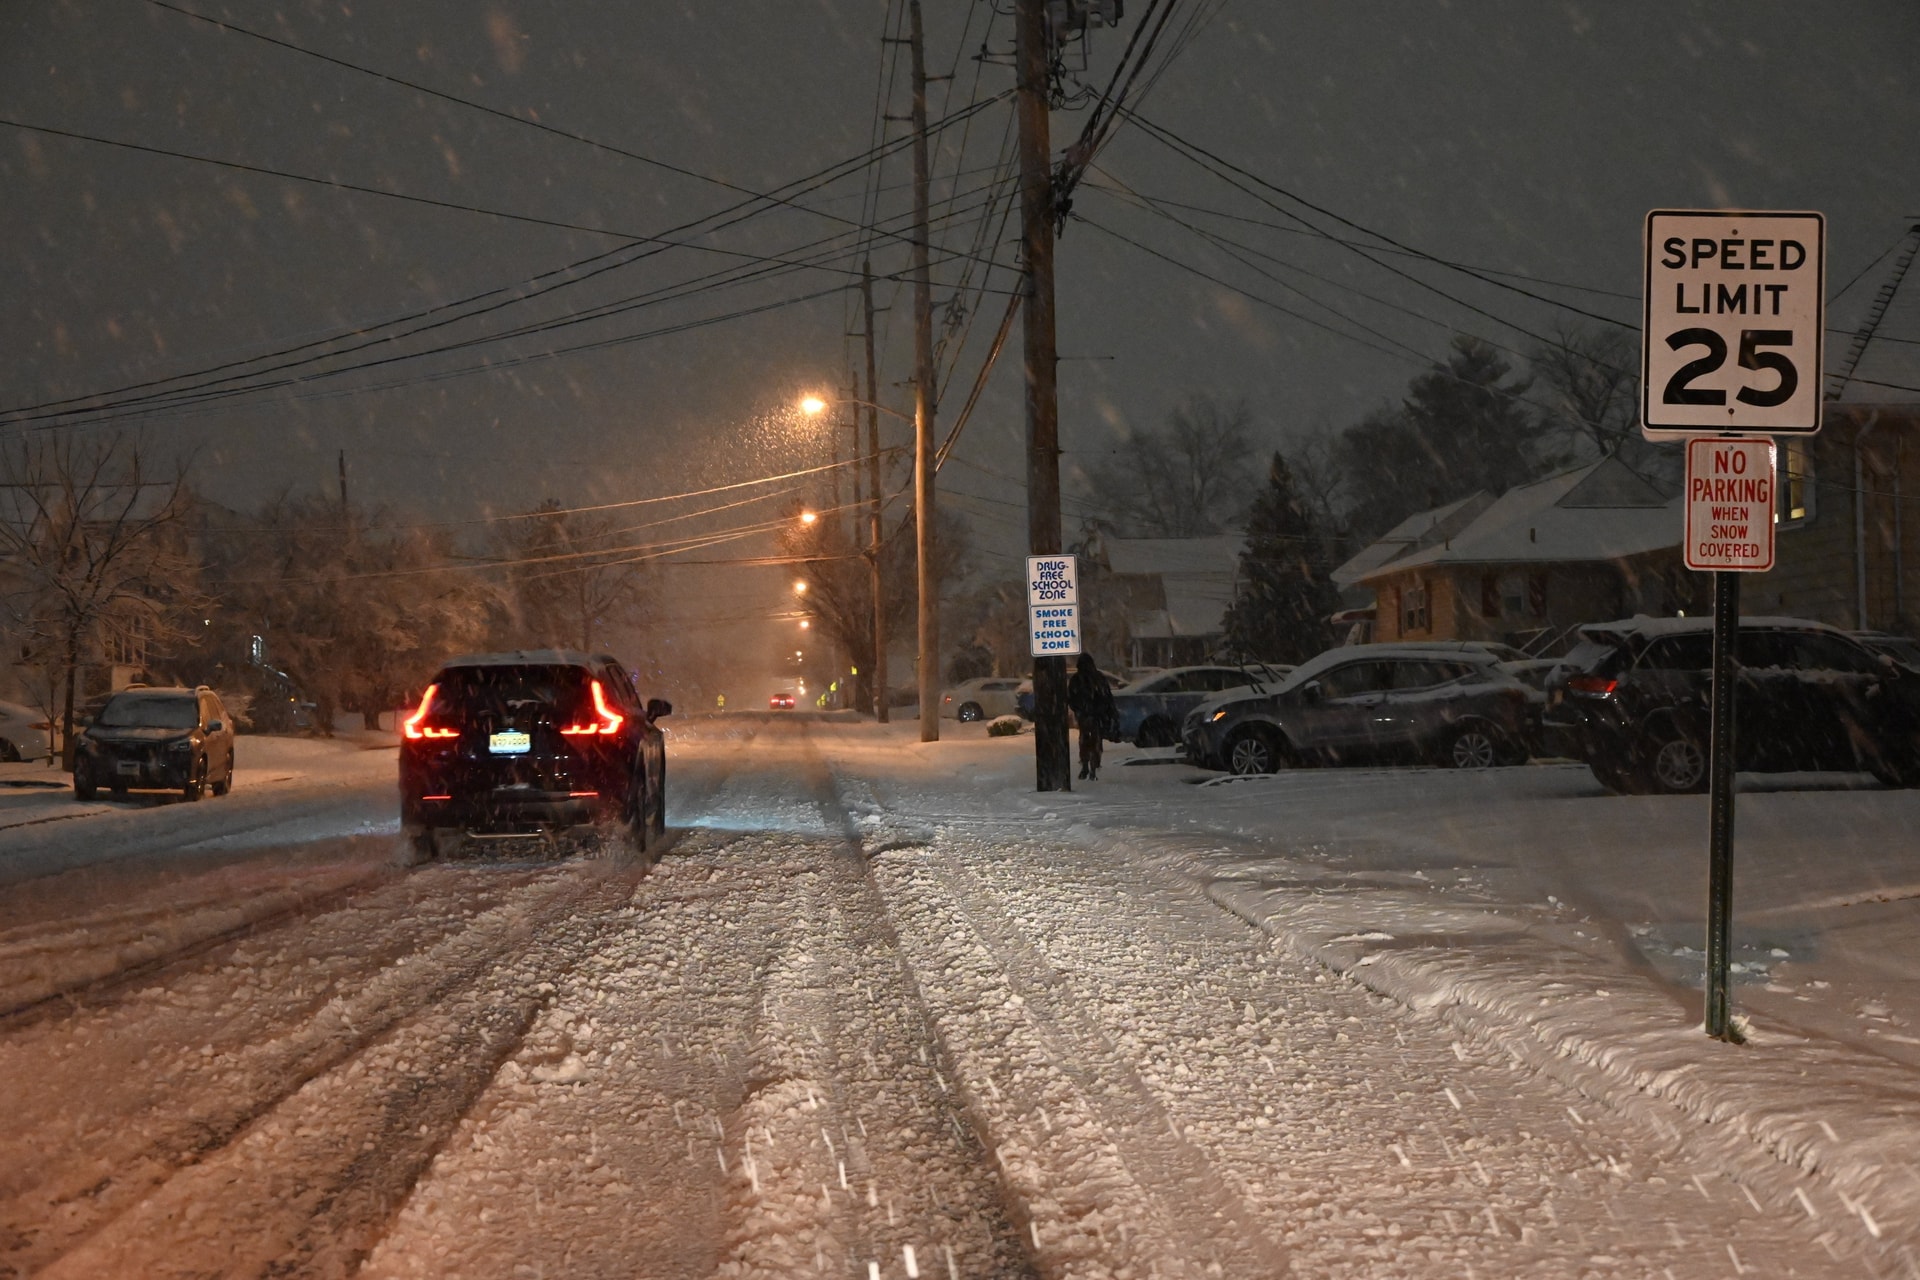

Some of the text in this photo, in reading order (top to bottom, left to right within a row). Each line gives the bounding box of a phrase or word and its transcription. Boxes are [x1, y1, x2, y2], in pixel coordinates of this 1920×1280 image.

[1661, 237, 1806, 270] SPEED
[1676, 283, 1788, 315] LIMIT
[1663, 328, 1798, 407] 25
[1715, 450, 1746, 474] NO
[1693, 478, 1768, 503] PARKING
[1711, 506, 1749, 521] WHEN
[1711, 525, 1748, 539] SNOW
[1699, 543, 1760, 558] COVERED
[1037, 561, 1069, 571] DRUG-
[1040, 571, 1063, 580] FREE
[1032, 580, 1073, 590] SCHOOL
[1039, 590, 1066, 600] ZONE
[1036, 609, 1073, 618] SMOKE
[1043, 620, 1067, 628] FREE
[1034, 630, 1076, 639] SCHOOL
[1042, 641, 1070, 649] ZONE
